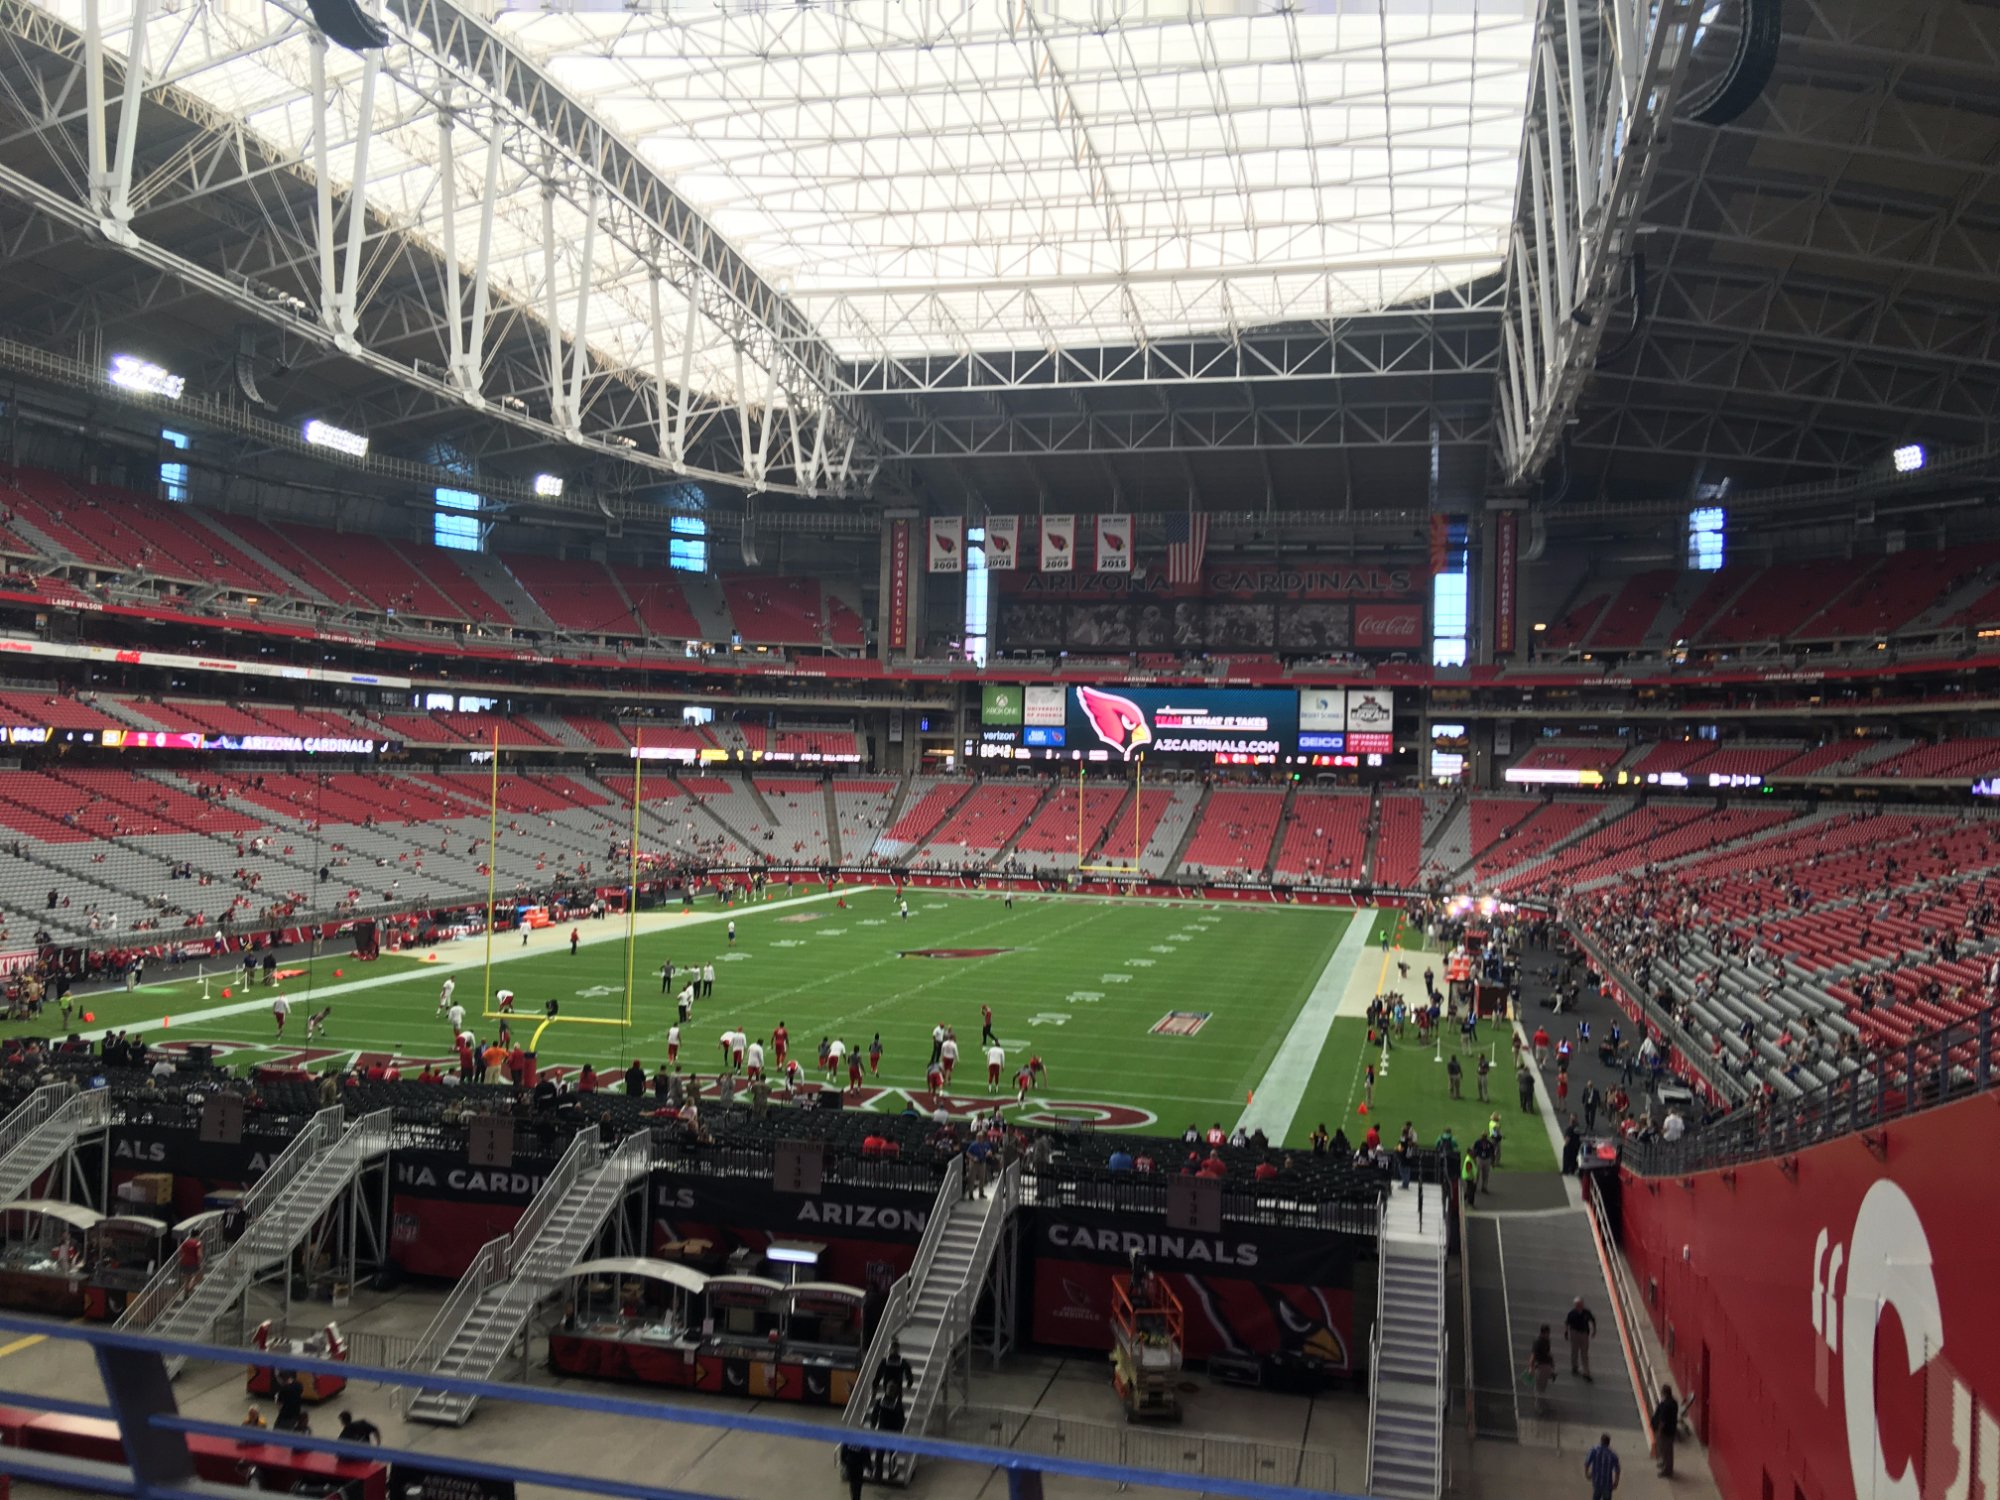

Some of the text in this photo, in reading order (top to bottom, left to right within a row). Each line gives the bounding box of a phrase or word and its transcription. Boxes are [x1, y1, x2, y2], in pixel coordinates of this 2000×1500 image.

[896, 532, 904, 606] FOOTBALL
[1024, 570, 1412, 593] ARIZONA CARDINALS
[52, 598, 103, 611] LARRY WILSON
[1154, 715, 1182, 725] TEAM
[1193, 716, 1223, 726] WHAT
[1236, 717, 1267, 726] TAKES
[983, 729, 1016, 742] verizon
[1299, 736, 1343, 748] GEICO
[242, 737, 373, 753] ARIZONA CARDINALS
[1153, 738, 1280, 754] AZCARDINALS.COM
[1048, 1224, 1259, 1266] CARDINALS
